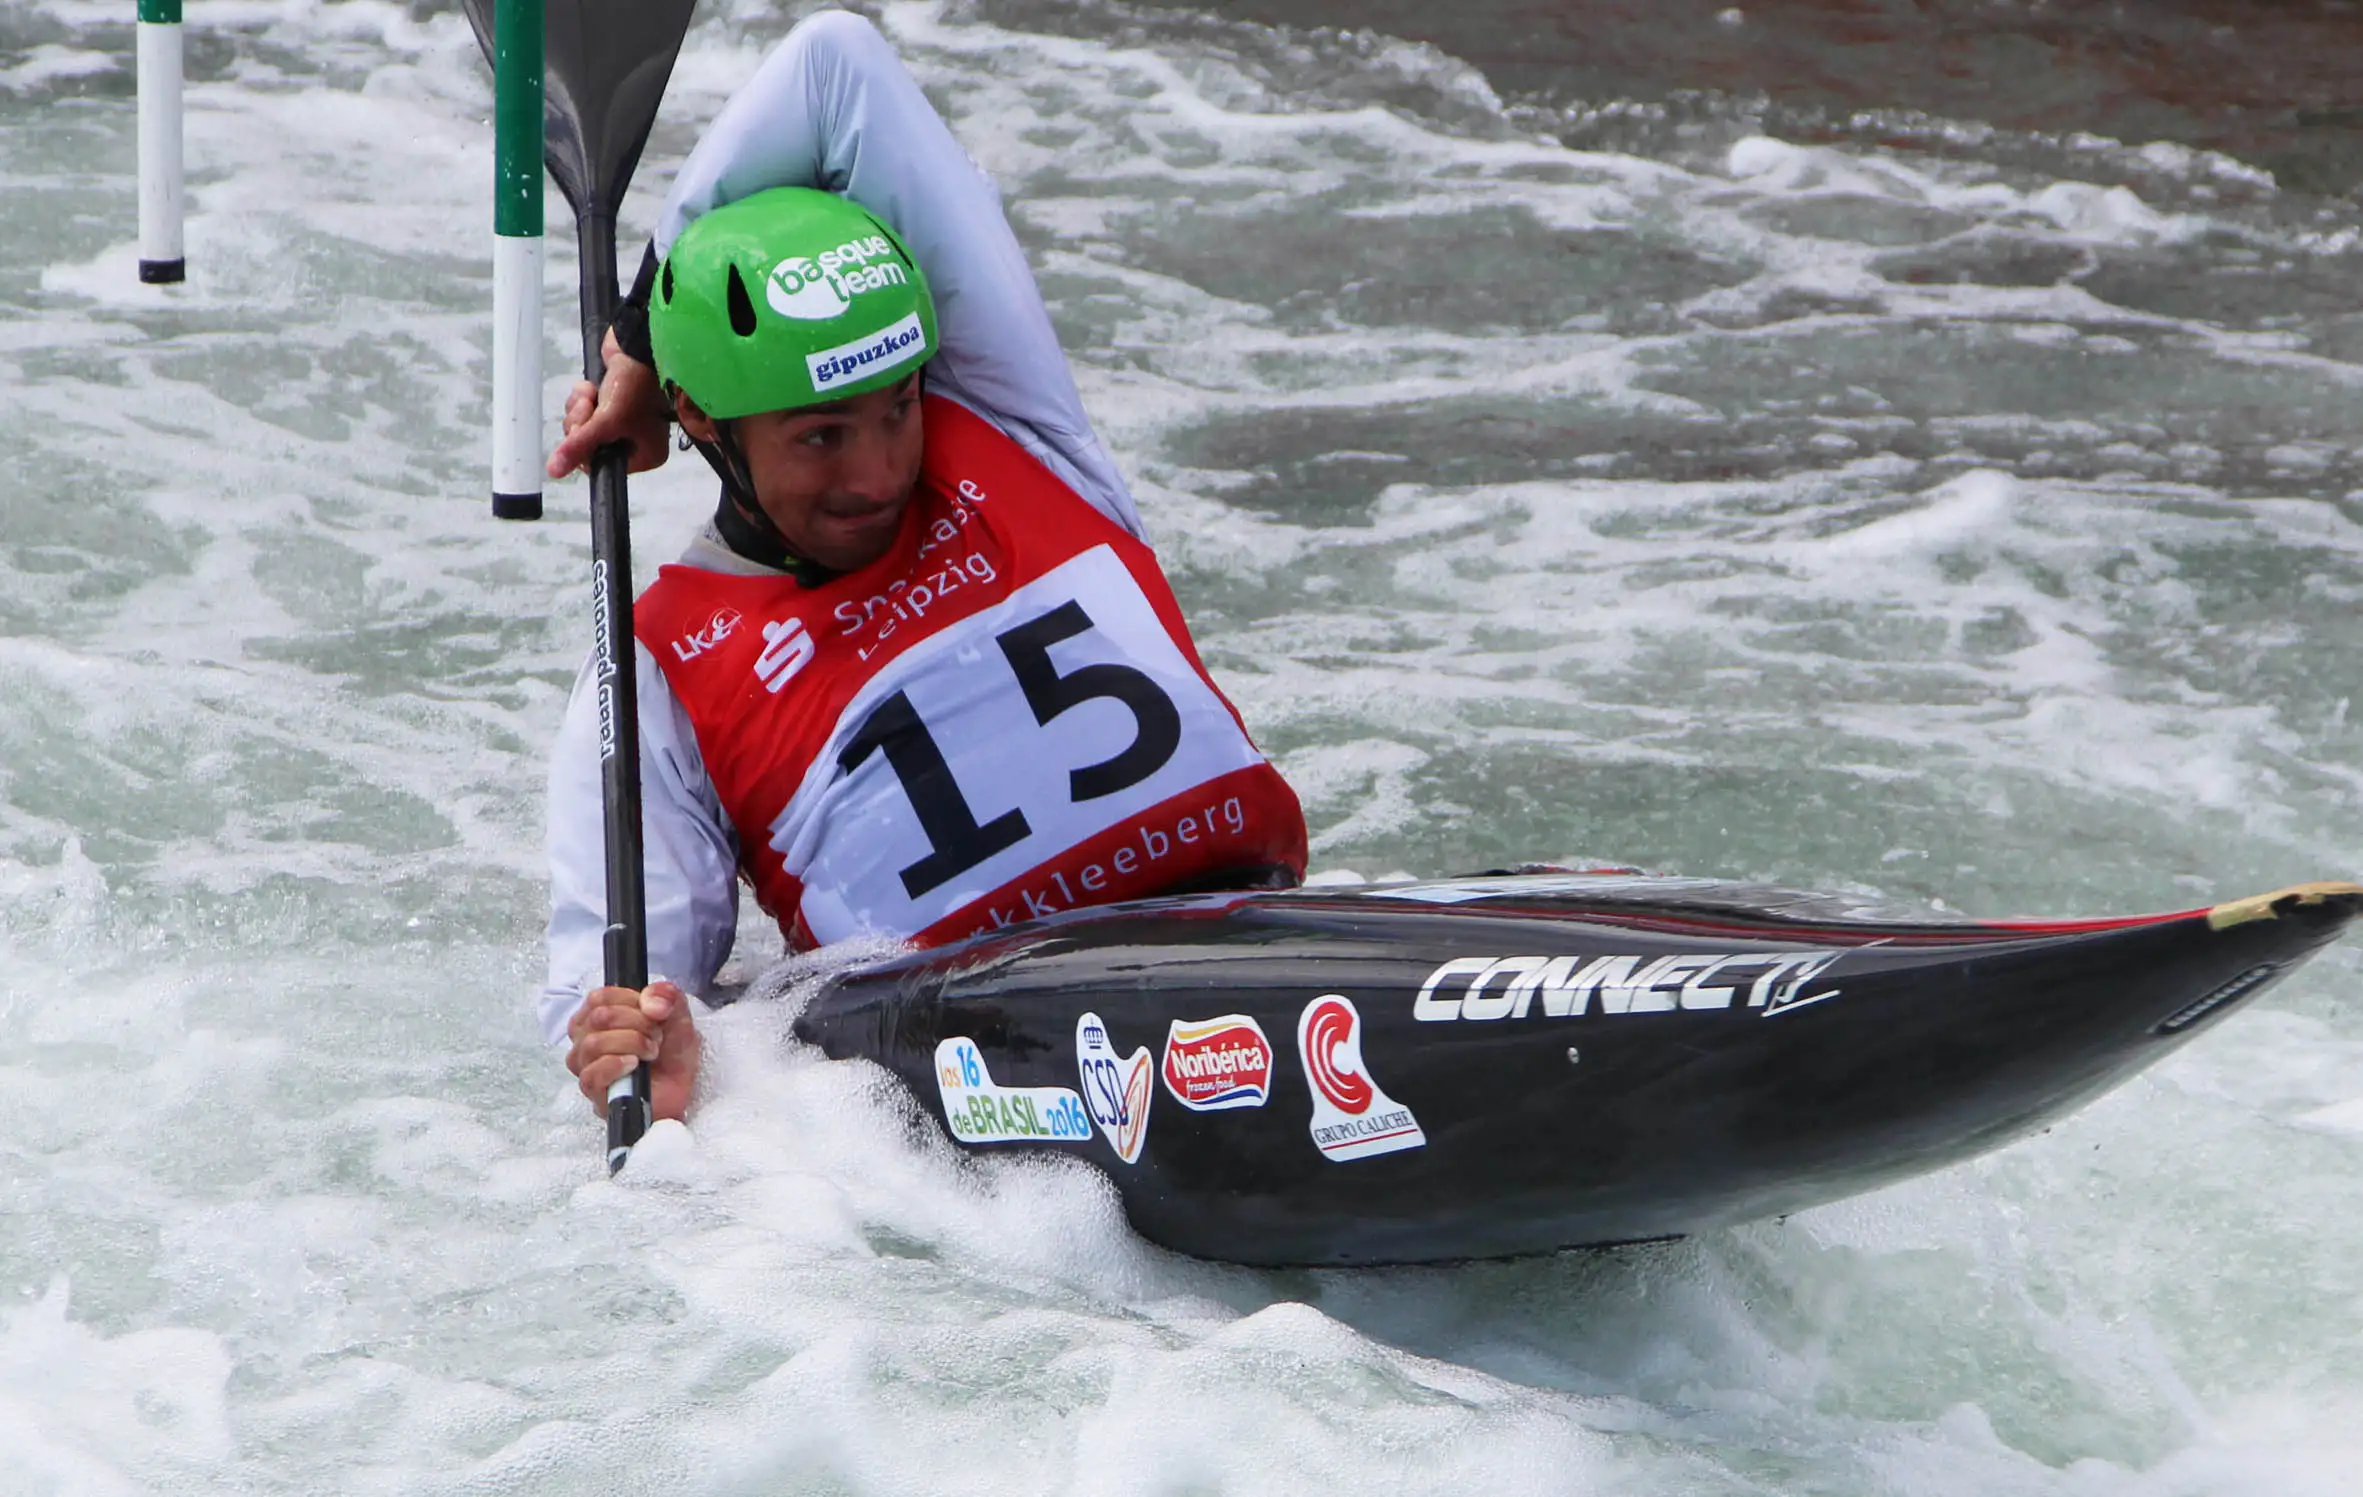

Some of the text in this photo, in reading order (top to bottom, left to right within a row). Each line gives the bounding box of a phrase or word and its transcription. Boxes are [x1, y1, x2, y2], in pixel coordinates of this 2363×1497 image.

[772, 235, 891, 294] basque
[826, 261, 908, 302] team
[815, 326, 919, 382] gipuzkoa
[837, 598, 1181, 901] 15
[970, 796, 1246, 939] kkleeberg
[1171, 1042, 1265, 1079] Noribérica
[1082, 1058, 1129, 1126] CSD
[1314, 1110, 1413, 1144] GRUPO CALICHE
